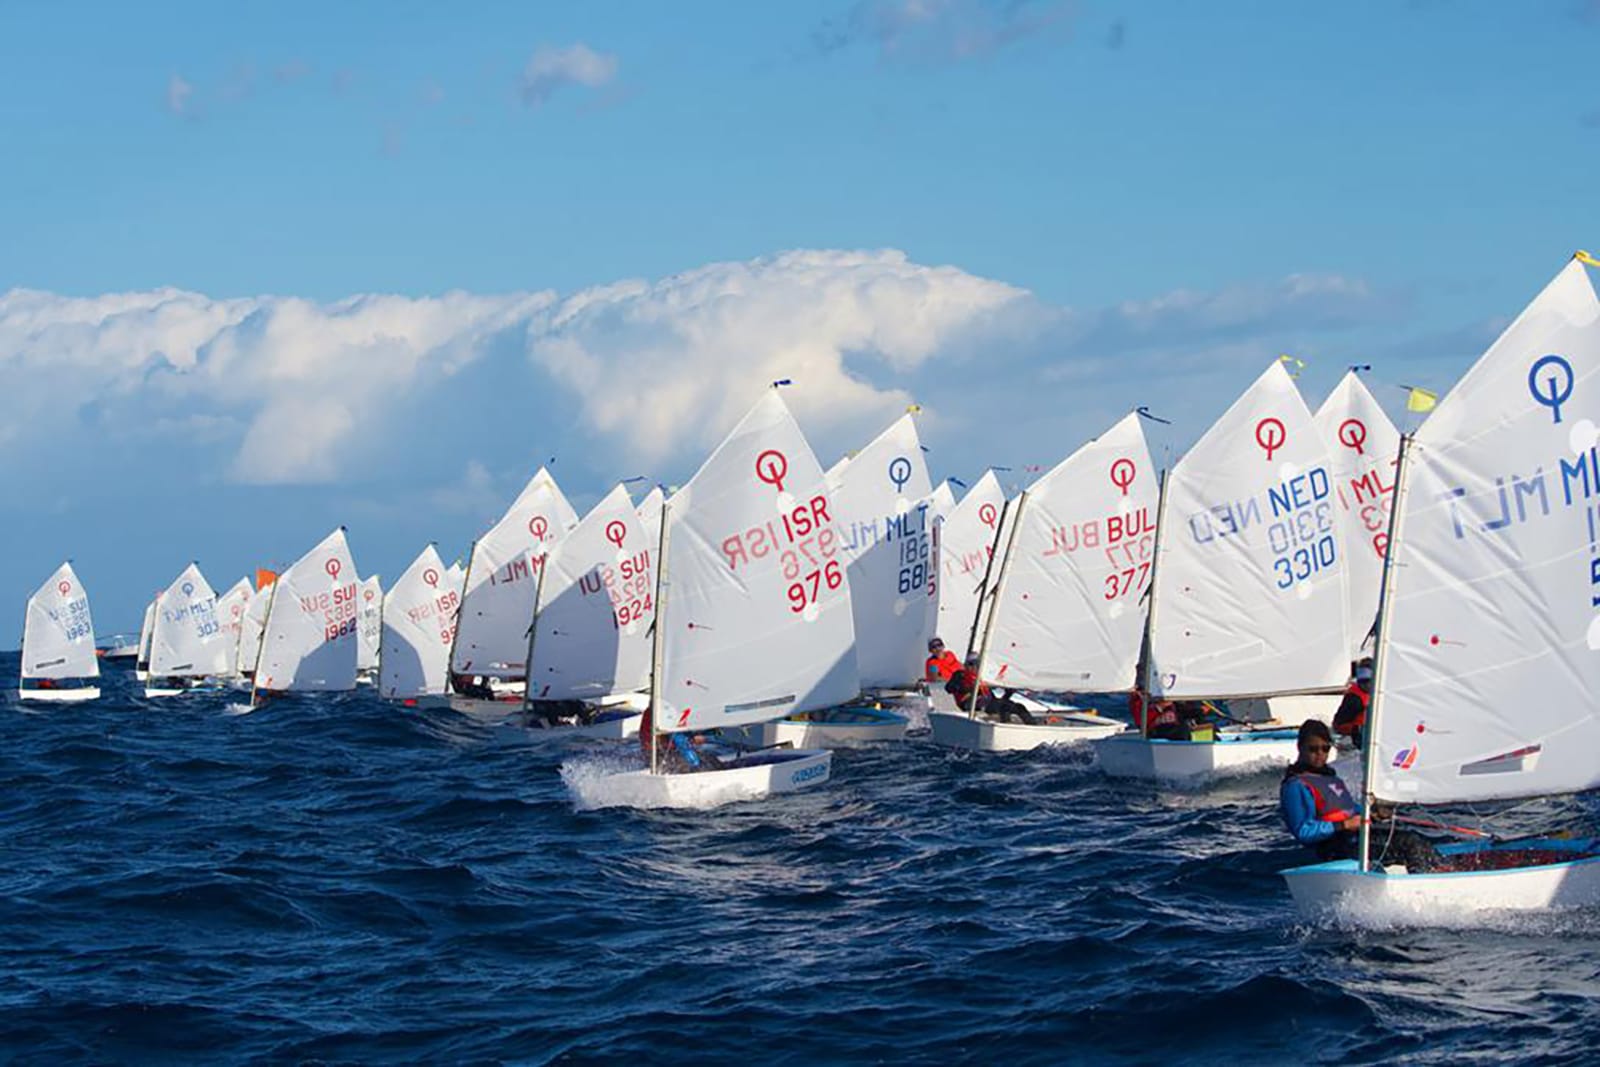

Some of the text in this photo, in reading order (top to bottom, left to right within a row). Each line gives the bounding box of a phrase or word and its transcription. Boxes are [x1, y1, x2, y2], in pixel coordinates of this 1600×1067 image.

[1268, 467, 1329, 517] NED
[782, 495, 831, 542] ISR
[886, 505, 928, 541] MLT
[1107, 508, 1156, 543] BUL
[620, 550, 650, 580] SUI
[899, 564, 927, 594] 681
[1273, 534, 1336, 589] 3310
[333, 583, 357, 605] SUI
[787, 560, 842, 612] 976
[1104, 562, 1150, 600] 377
[189, 598, 214, 615] MLT
[436, 591, 459, 612] ISR
[325, 617, 358, 643] 1962
